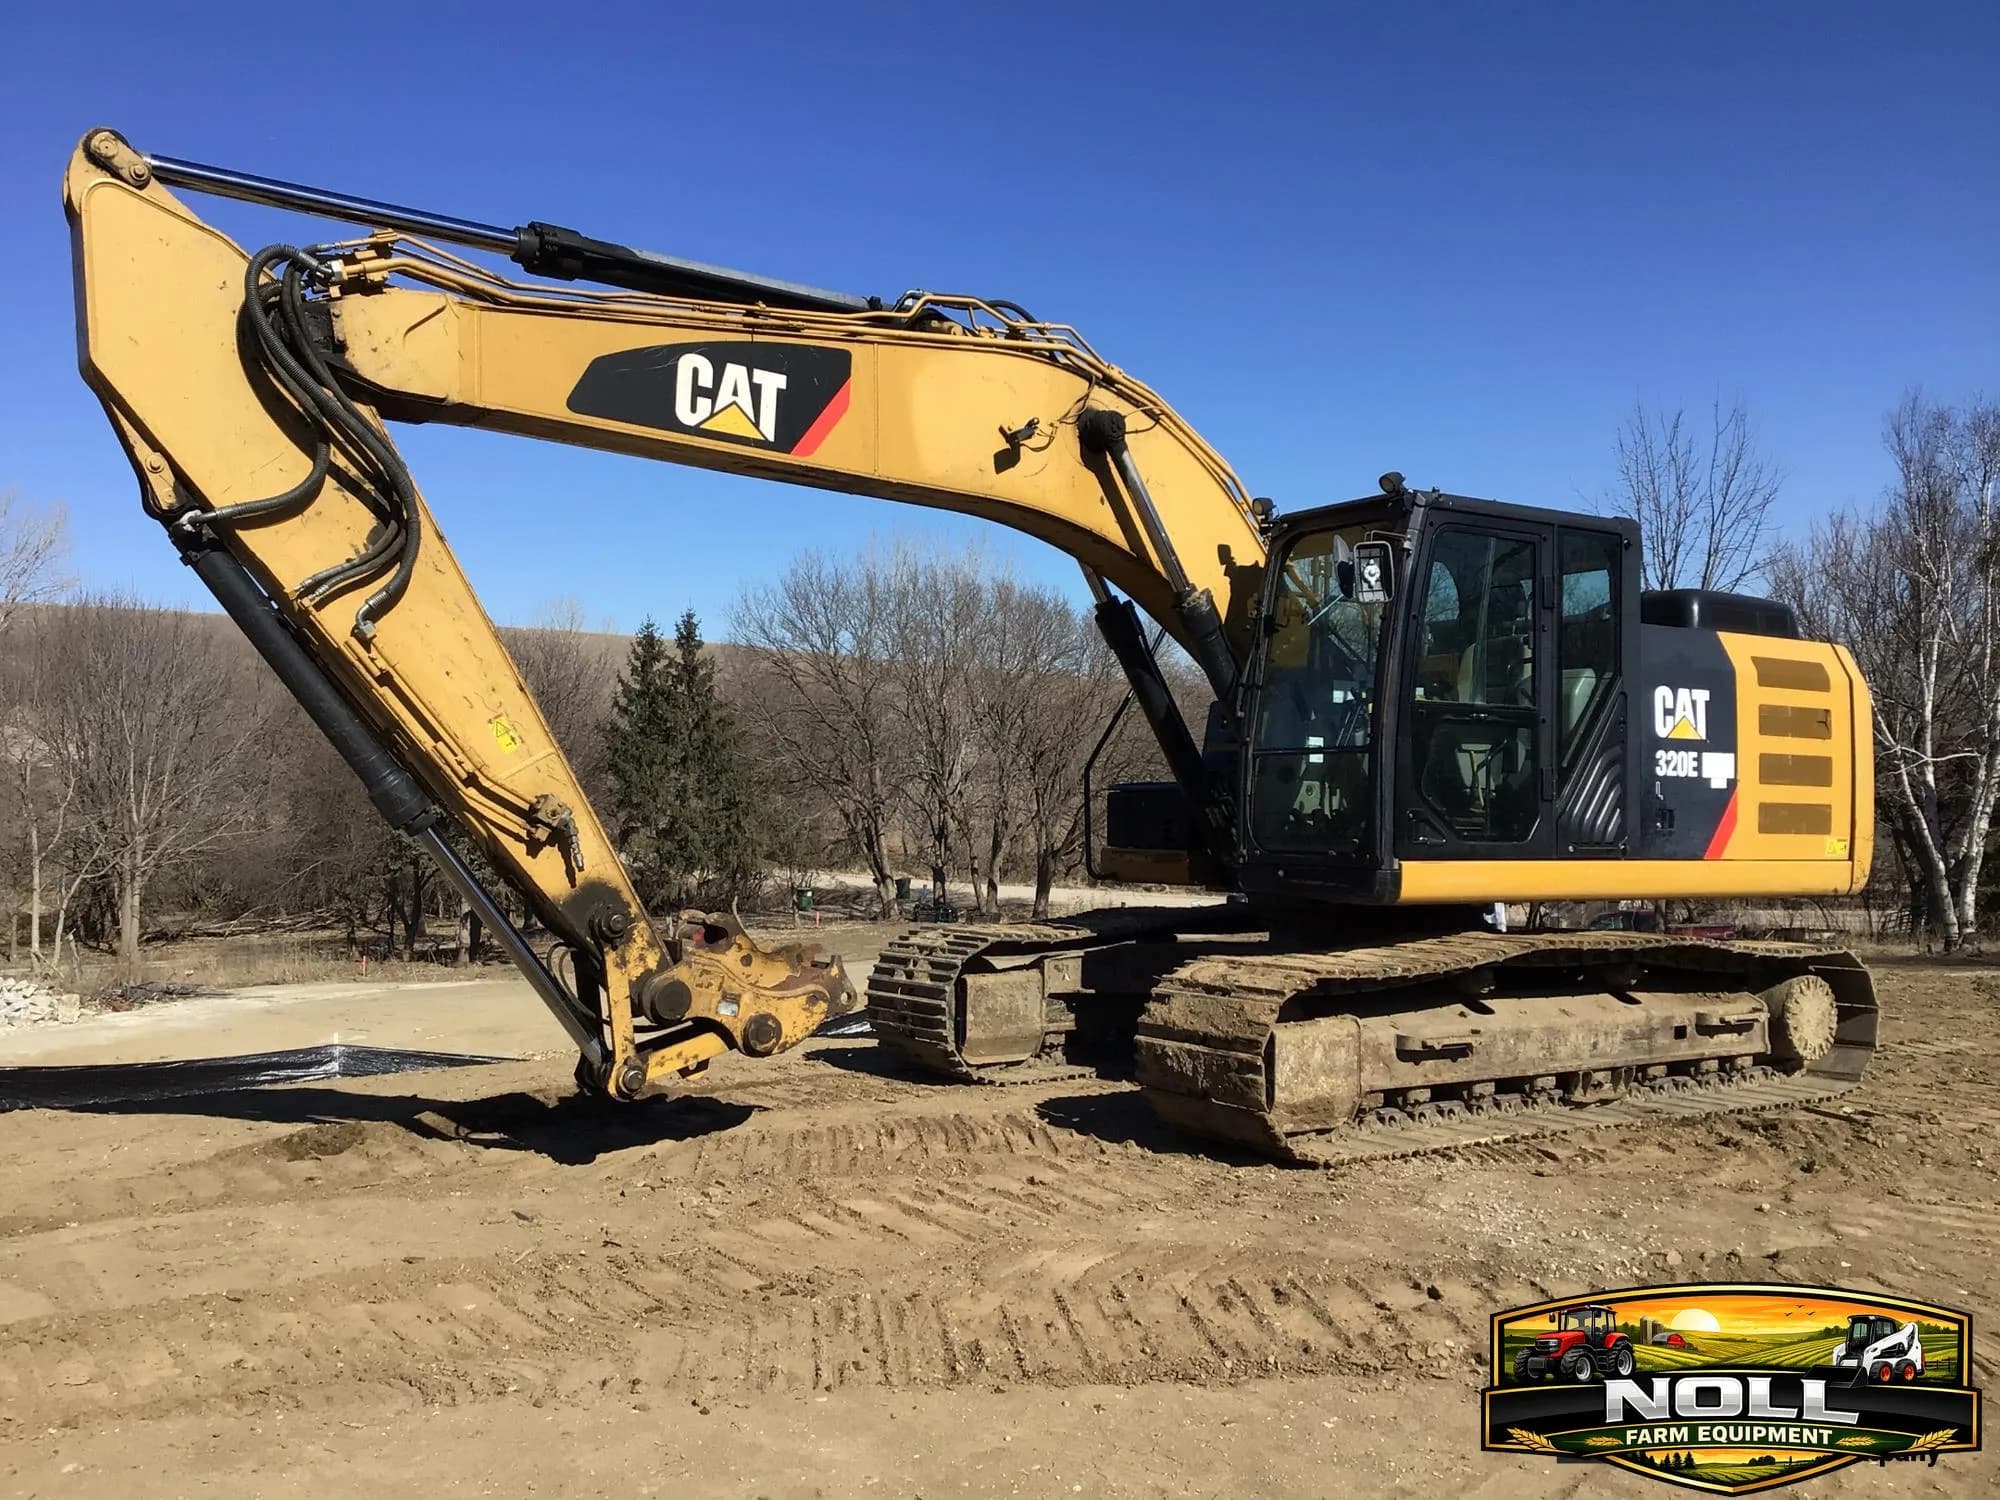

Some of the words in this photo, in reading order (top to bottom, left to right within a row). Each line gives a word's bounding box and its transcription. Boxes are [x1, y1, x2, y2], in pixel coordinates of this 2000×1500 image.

[675, 353, 787, 442] CAT
[1654, 685, 1710, 740] CAT
[1655, 750, 1698, 777] 320E
